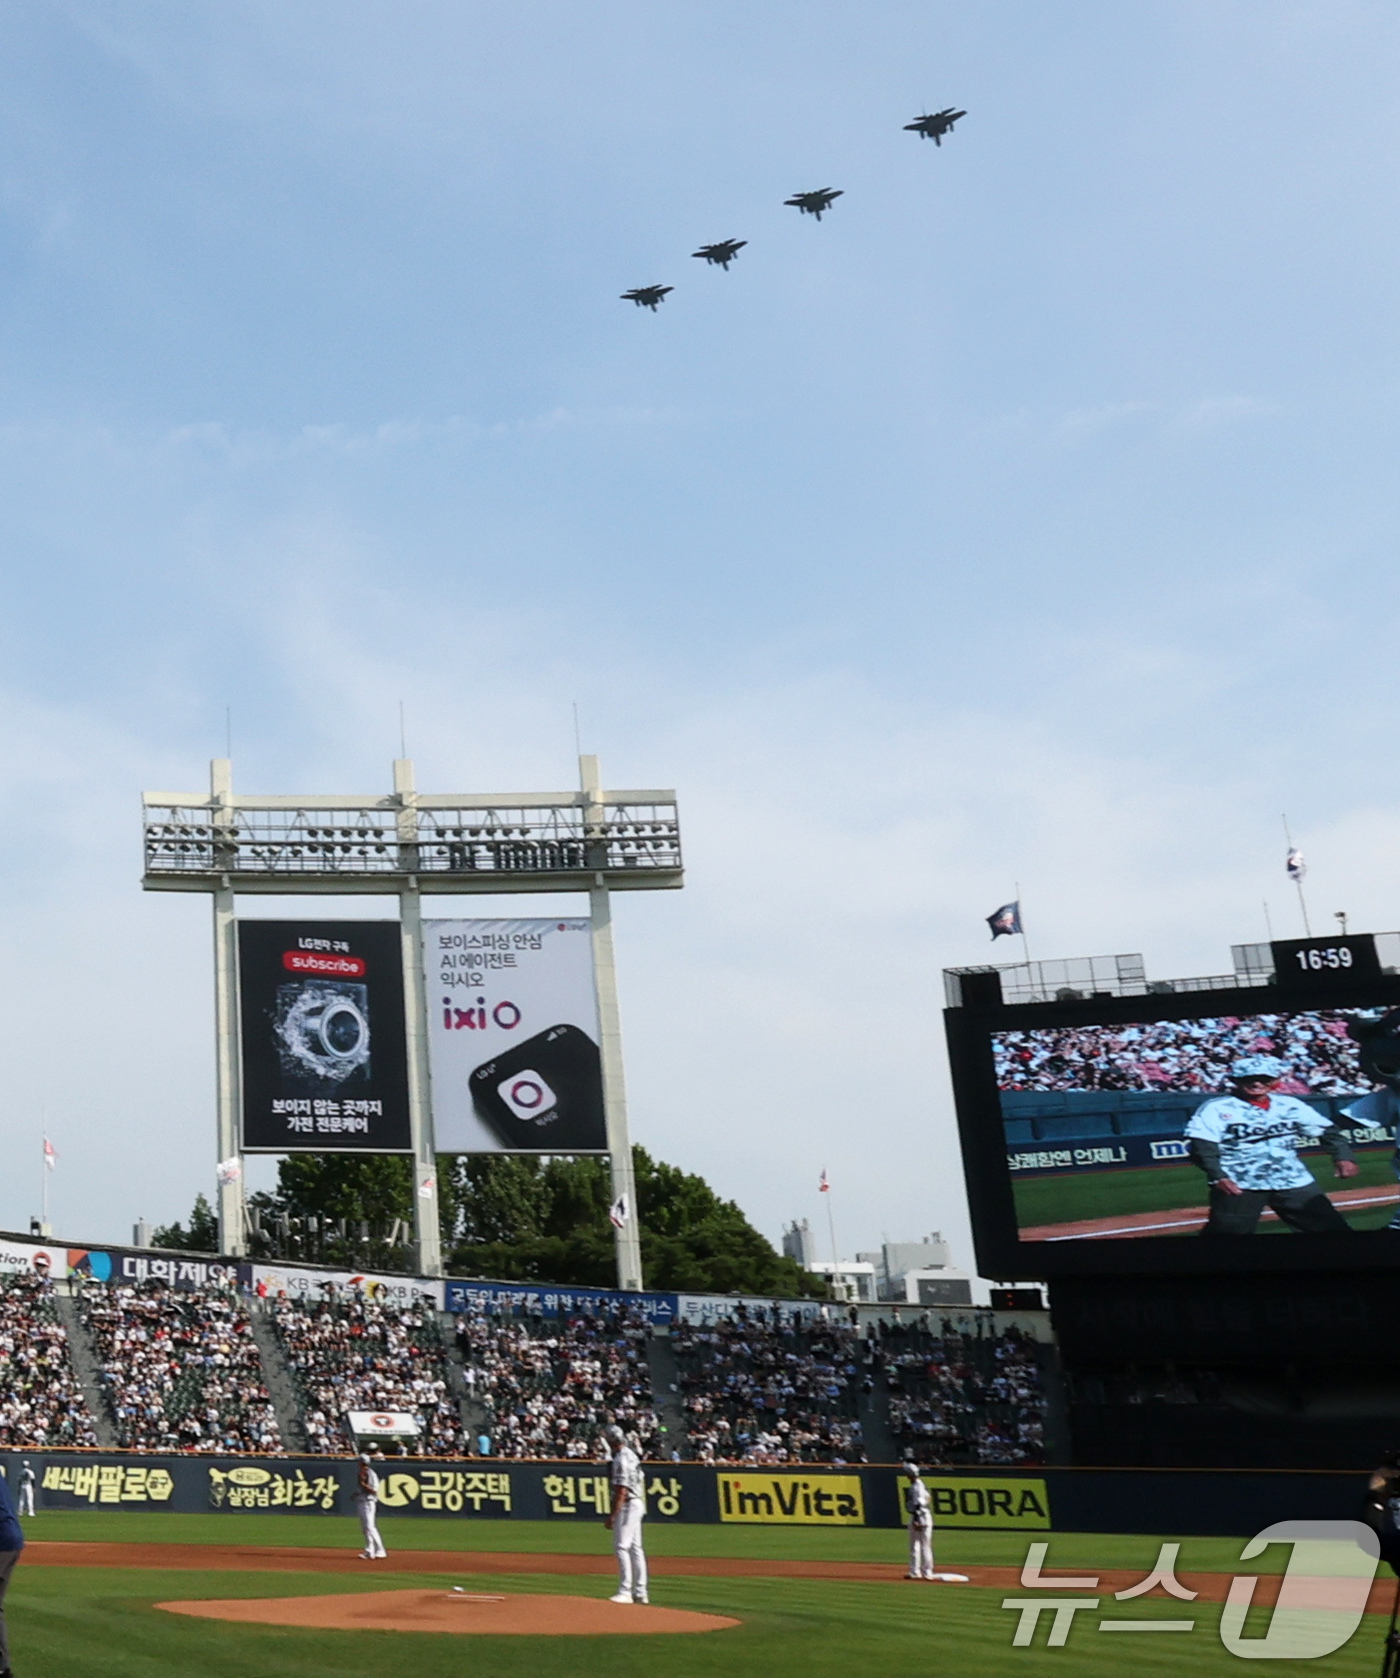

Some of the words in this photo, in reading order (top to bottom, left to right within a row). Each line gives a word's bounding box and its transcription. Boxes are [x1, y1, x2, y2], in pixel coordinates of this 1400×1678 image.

[439, 934, 510, 950] 보이스피싱
[513, 934, 542, 950] 안심
[292, 956, 359, 973] subscribe
[440, 954, 457, 969] AI
[459, 953, 518, 969] 에이전트
[1295, 946, 1352, 970] 16:59
[440, 972, 485, 988] 익시오
[272, 1099, 311, 1115] 보이지
[313, 1099, 340, 1115] 않는
[342, 1099, 383, 1116] 곳까지
[287, 1116, 314, 1132] 가전
[316, 1116, 369, 1133] 전문케어
[1074, 1147, 1128, 1165] 언제나
[41, 1464, 148, 1503] 세신버팔로
[227, 1487, 270, 1507] 실장님
[269, 1469, 341, 1509] 회초장
[420, 1471, 512, 1512] 금강주택
[542, 1474, 682, 1516] 현대상
